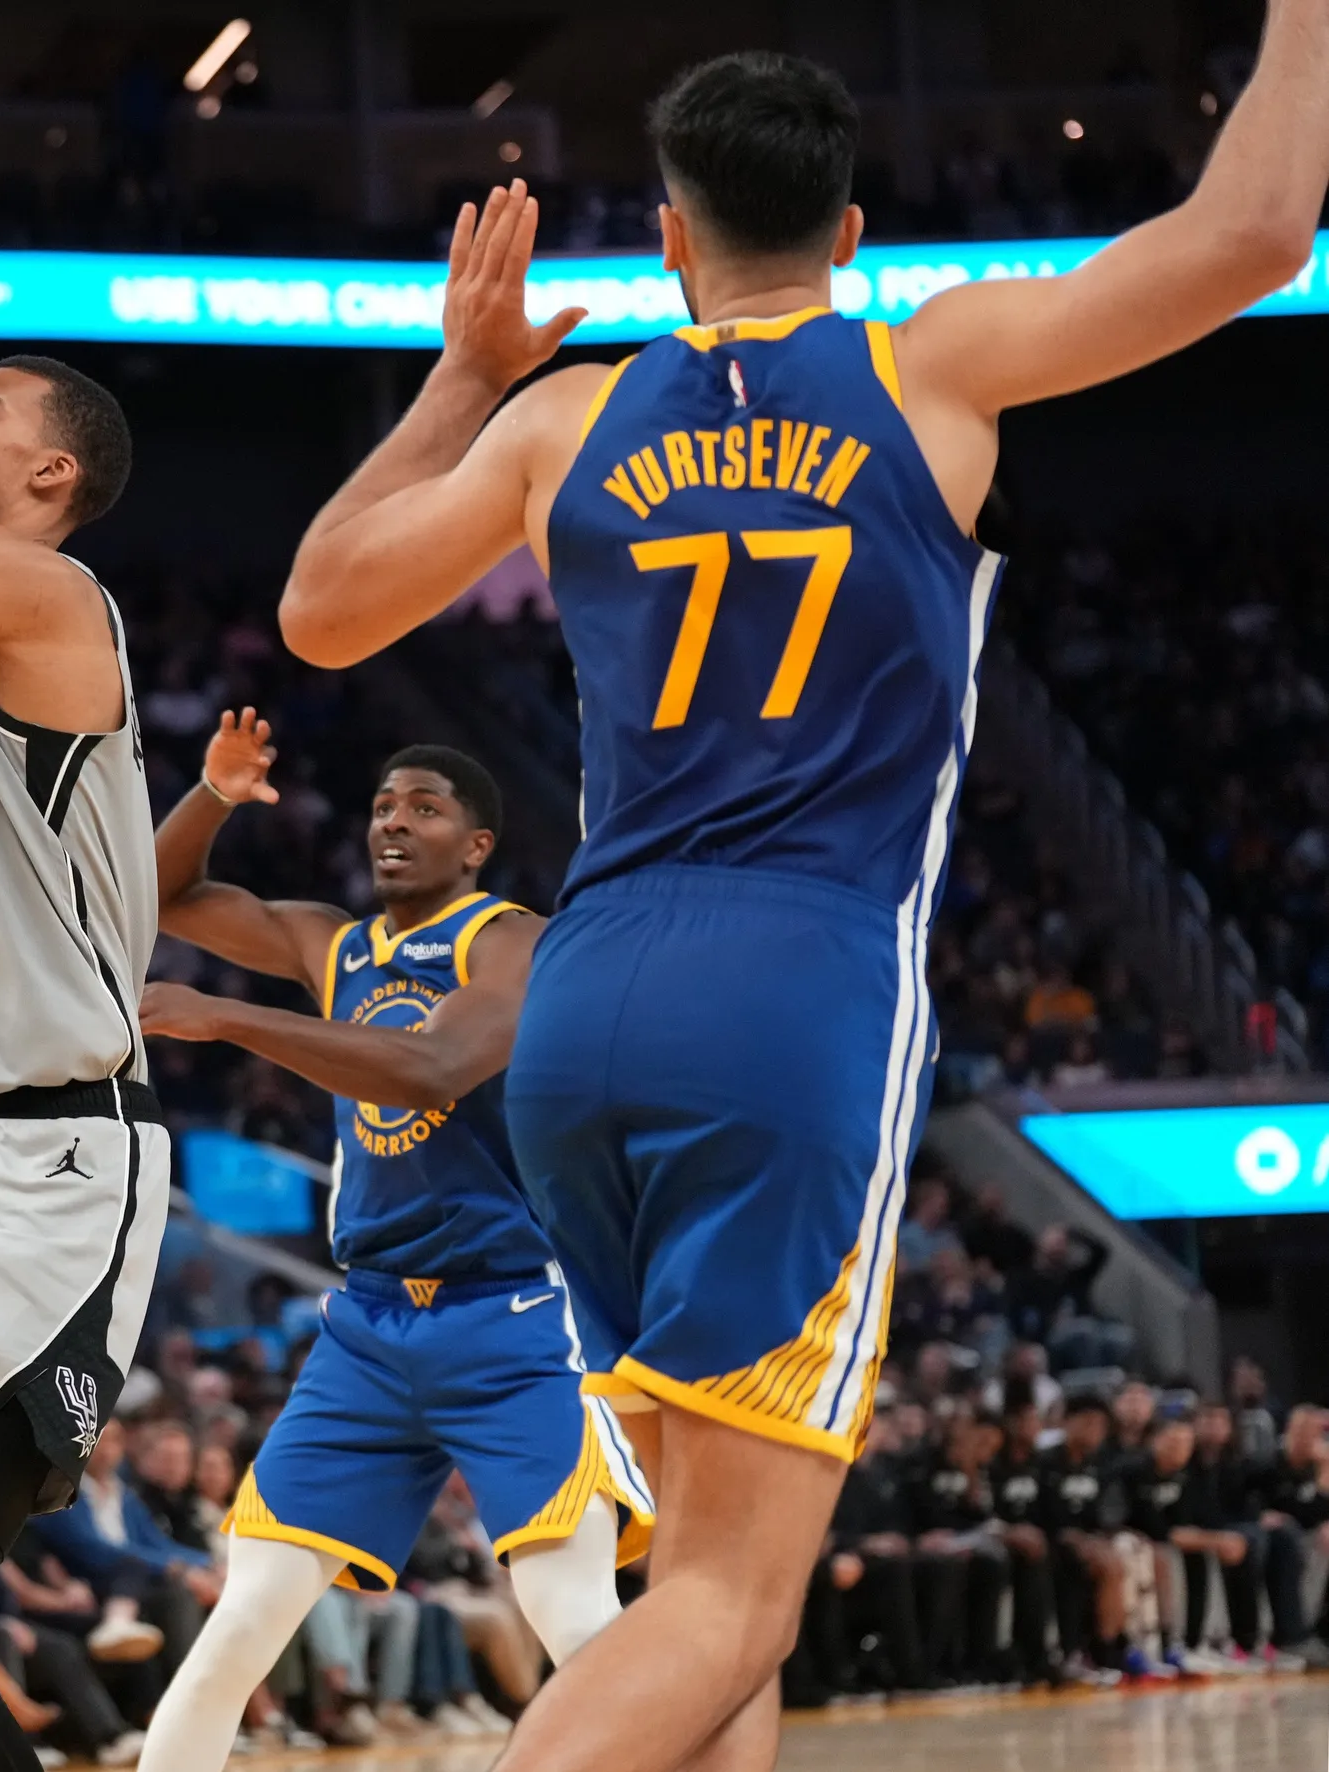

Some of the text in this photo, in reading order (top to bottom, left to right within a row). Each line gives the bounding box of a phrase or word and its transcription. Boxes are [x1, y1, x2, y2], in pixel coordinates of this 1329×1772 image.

[603, 418, 871, 520] YURTSEVEN
[628, 525, 853, 731] 77
[403, 942, 452, 958] Rakuten
[349, 979, 408, 1024] OLDEN
